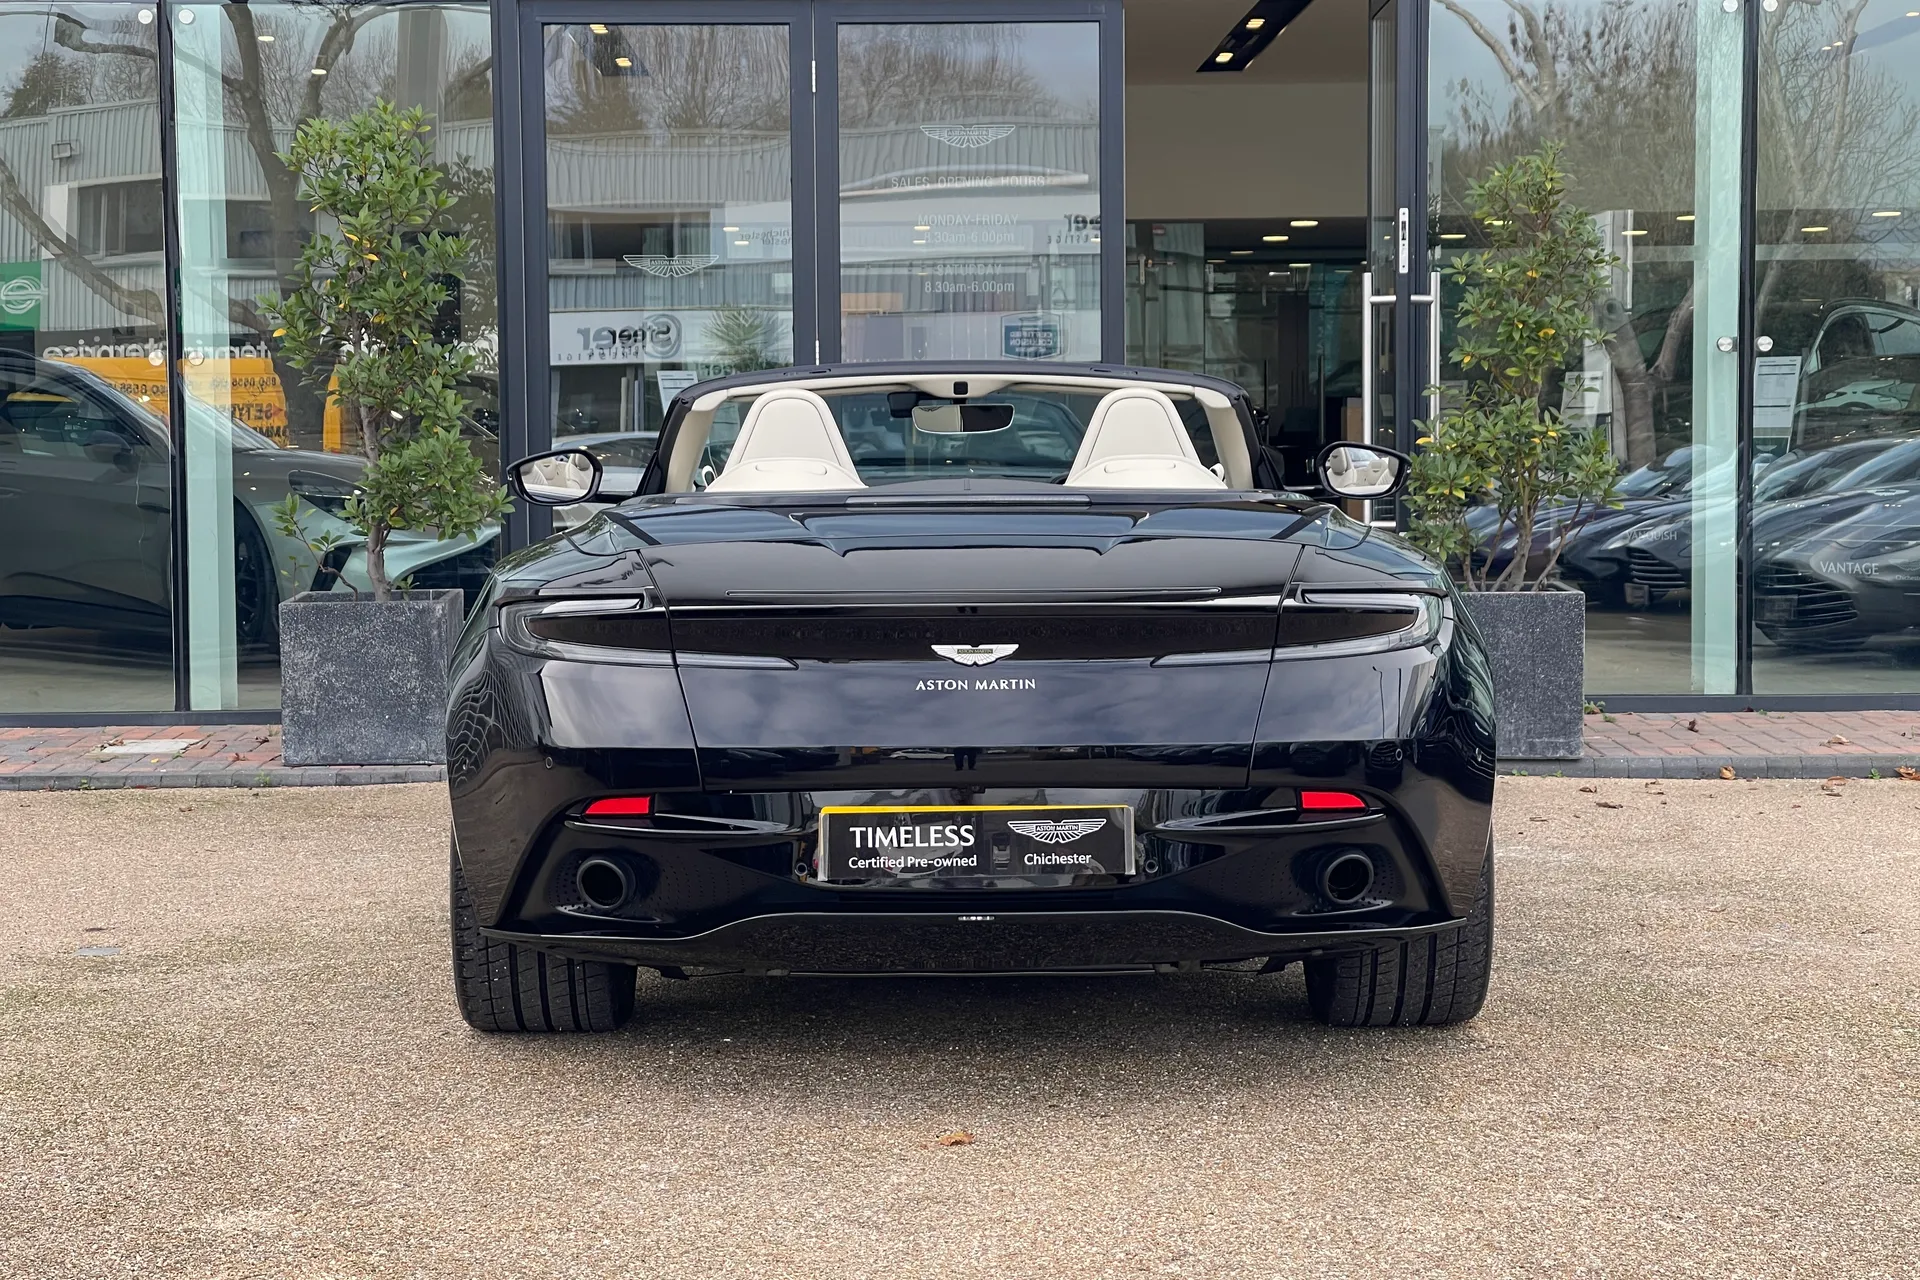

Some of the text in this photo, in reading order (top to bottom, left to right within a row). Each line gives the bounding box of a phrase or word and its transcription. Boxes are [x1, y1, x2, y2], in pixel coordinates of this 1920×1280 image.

[891, 175, 1045, 189] SALES OPENING HOURS
[917, 213, 1019, 226] MONDAY-FRIDAY
[924, 231, 1014, 244] 8.30am-6.00pm
[937, 264, 1002, 276] SATURDAY
[924, 280, 1014, 294] 8.30am-6.00pm
[1627, 530, 1678, 541] VANQUISH
[1819, 561, 1880, 575] VANTAGE
[915, 678, 1036, 691] ASTON MARTIN
[1035, 824, 1056, 832] ASTON
[849, 824, 976, 849] TIMELESS
[848, 854, 978, 869] Certified Pre-owned
[1023, 852, 1093, 866] Chichester
